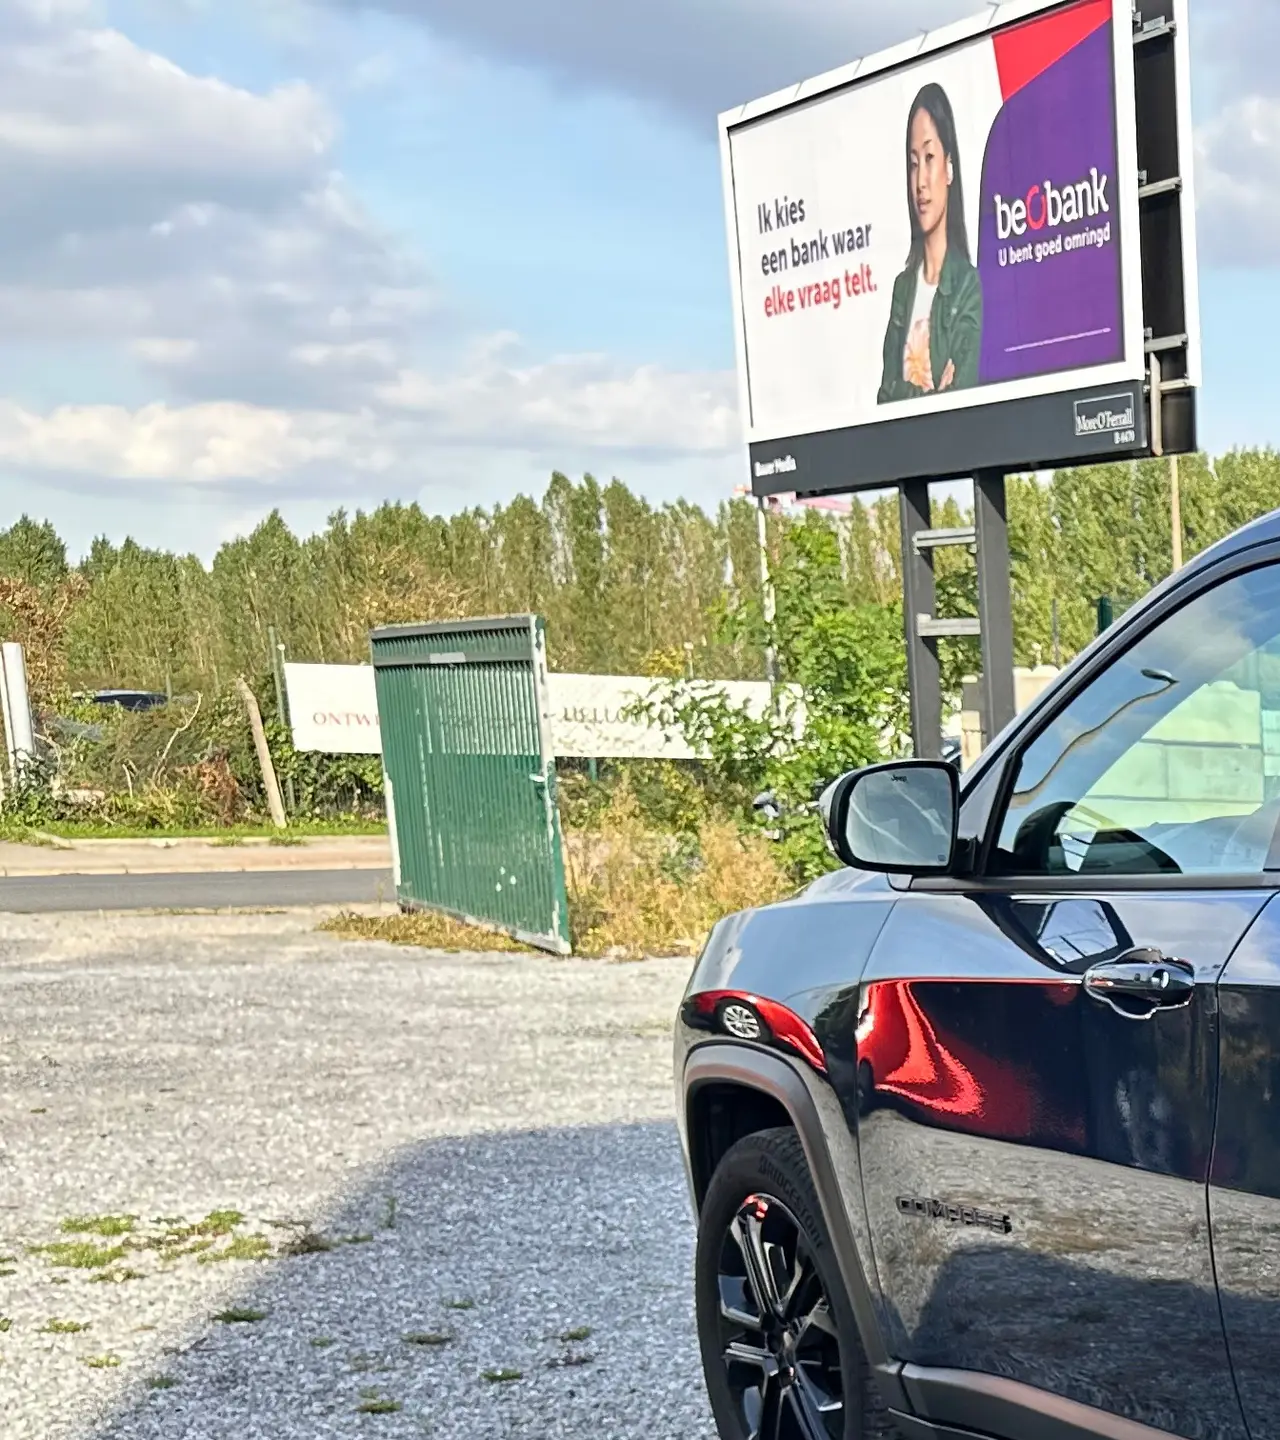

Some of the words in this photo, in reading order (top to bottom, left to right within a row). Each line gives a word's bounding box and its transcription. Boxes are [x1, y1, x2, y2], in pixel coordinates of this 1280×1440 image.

[758, 202, 773, 234] Ik
[775, 195, 805, 229] kies
[761, 248, 788, 276] een
[790, 228, 829, 268] bank
[832, 223, 872, 256] waar
[998, 247, 1007, 266] U
[1009, 242, 1033, 264] bent
[1035, 233, 1062, 262] goed
[1064, 220, 1110, 251] omringd
[764, 285, 795, 318] elke
[797, 278, 841, 309] vraag
[845, 262, 878, 297] telt.
